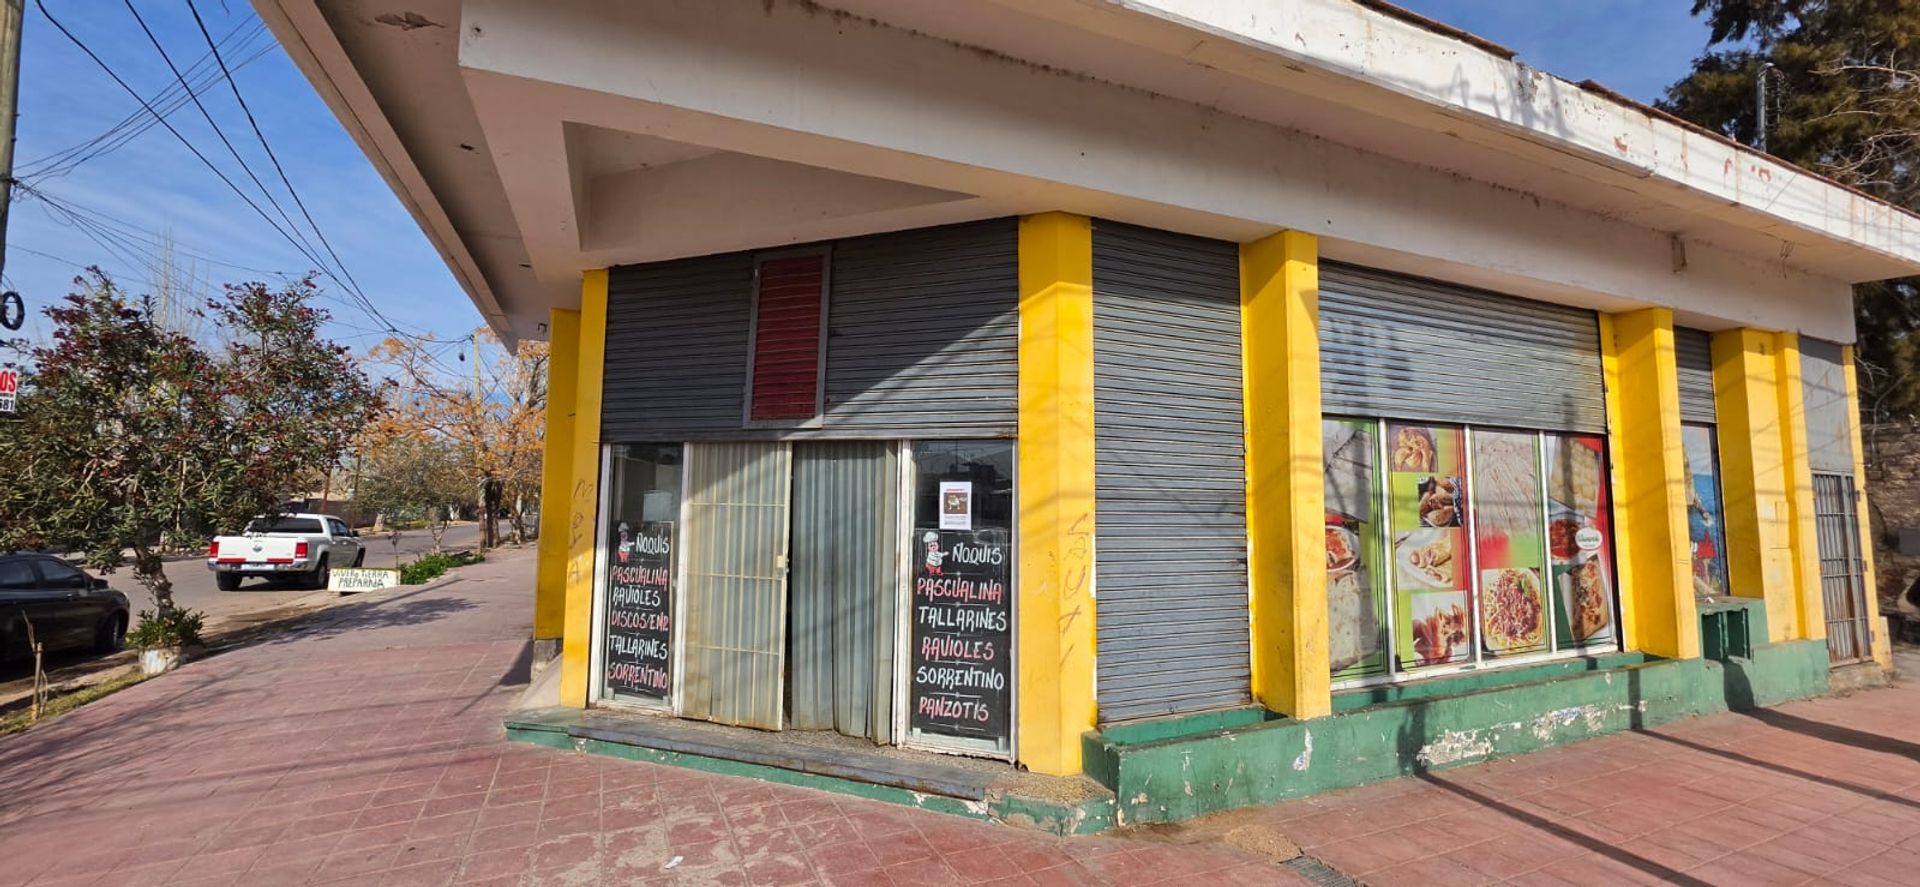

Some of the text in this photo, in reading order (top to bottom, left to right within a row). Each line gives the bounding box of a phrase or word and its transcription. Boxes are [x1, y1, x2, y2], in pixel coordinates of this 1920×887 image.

[0, 371, 16, 392] OS
[611, 565, 669, 592] PASCUALINA
[916, 577, 1002, 605] PASCUALINA
[613, 585, 661, 608] RAVIOLES
[918, 606, 1007, 632] TALLARINES
[609, 634, 668, 660] TALLARINES
[921, 635, 994, 661] RAVIOLES
[608, 662, 668, 689] SORRENTINO
[916, 666, 1004, 690] SORRENTINO
[919, 696, 989, 721] PANZOTIS
